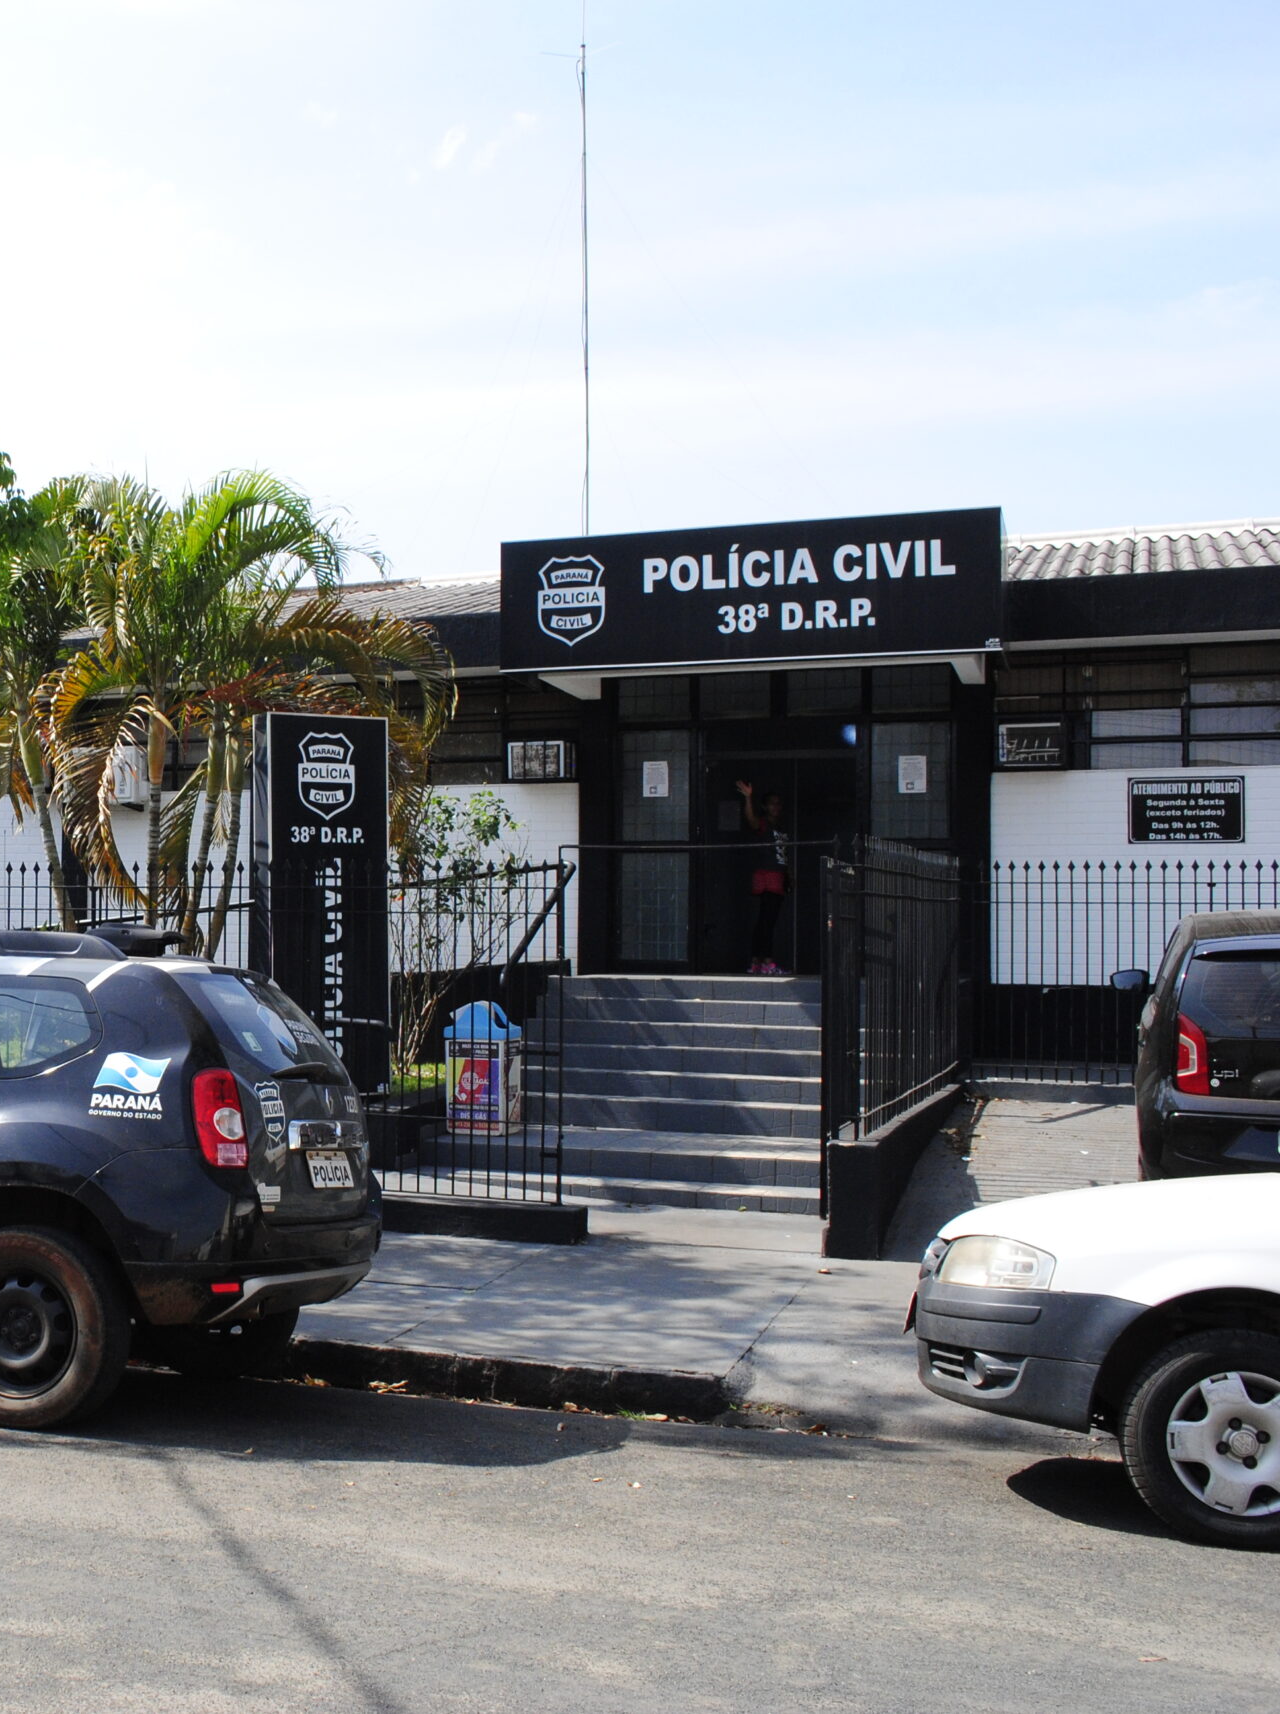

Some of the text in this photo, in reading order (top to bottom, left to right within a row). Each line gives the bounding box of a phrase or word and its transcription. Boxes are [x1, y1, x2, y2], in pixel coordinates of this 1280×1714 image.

[643, 539, 956, 594] POLÍCIA CIVIL
[781, 597, 876, 631] D.R.P.
[555, 617, 587, 628] CIVIL
[301, 765, 351, 779] POLÍCIA
[1132, 780, 1240, 795] ATENDIMENTO AO PÚBLICO
[314, 792, 342, 802] CIVIL
[1146, 799, 1187, 808] Segunda
[1146, 808, 1225, 818] (exceto feriados)
[1171, 821, 1184, 829] 9h
[321, 826, 365, 844] D.R.P.
[1149, 832, 1167, 840] Das
[1169, 832, 1186, 840] 14h
[90, 1093, 163, 1111] PARANÁ
[88, 1108, 122, 1117] GOVERNO
[134, 1112, 162, 1120] ESTADO
